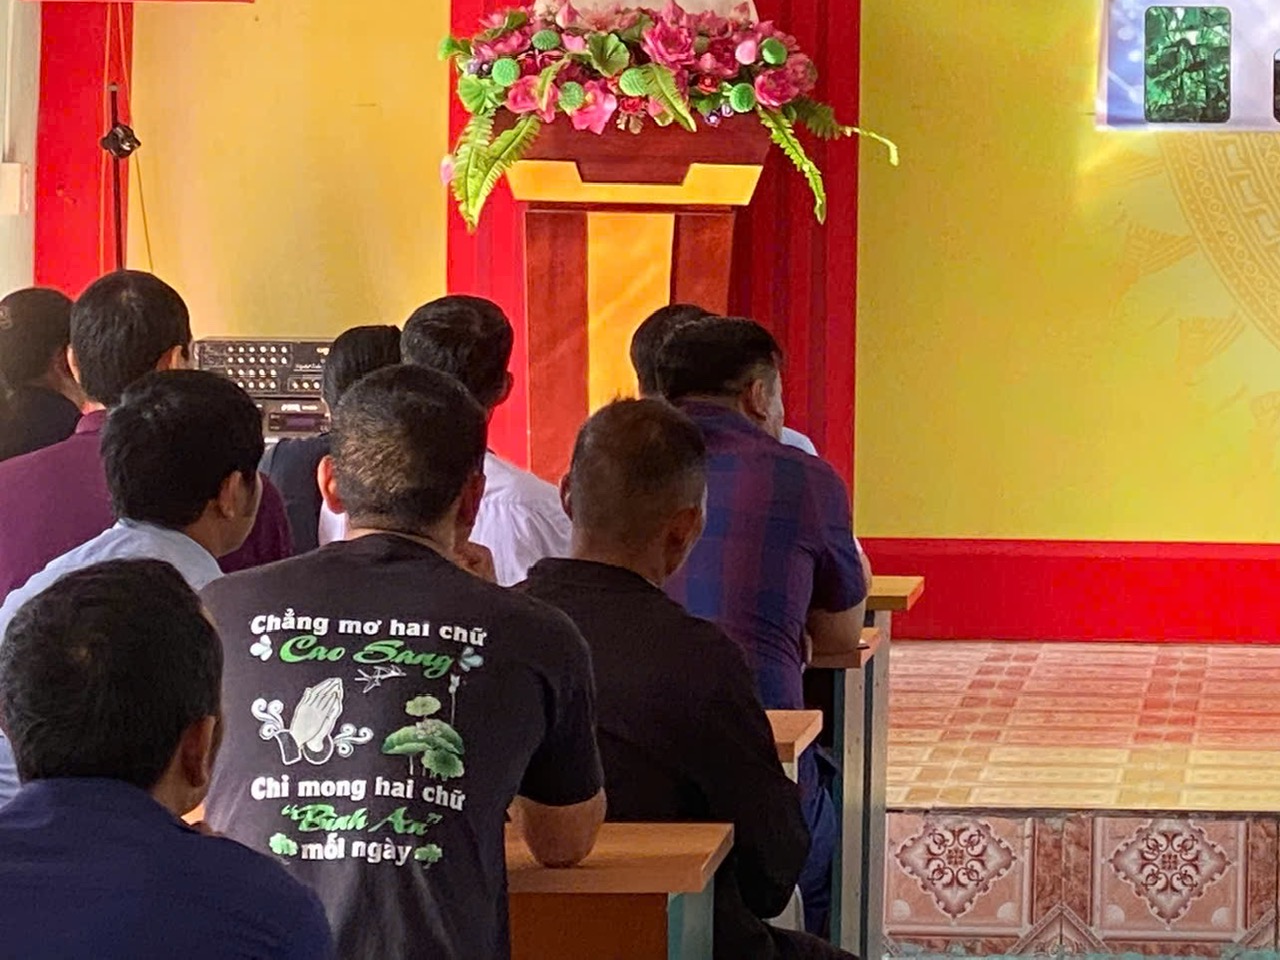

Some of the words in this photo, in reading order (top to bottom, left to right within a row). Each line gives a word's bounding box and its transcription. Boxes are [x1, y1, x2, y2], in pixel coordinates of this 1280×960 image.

[250, 608, 329, 636] Chẳng
[338, 619, 382, 635] mơ
[390, 619, 430, 637] hai
[439, 625, 488, 647] chữ
[280, 635, 345, 663] Cao
[353, 640, 454, 679] Sang
[298, 778, 367, 801] mong
[375, 776, 415, 800] hai
[422, 785, 467, 812] chữ
[351, 837, 413, 866] ngày
